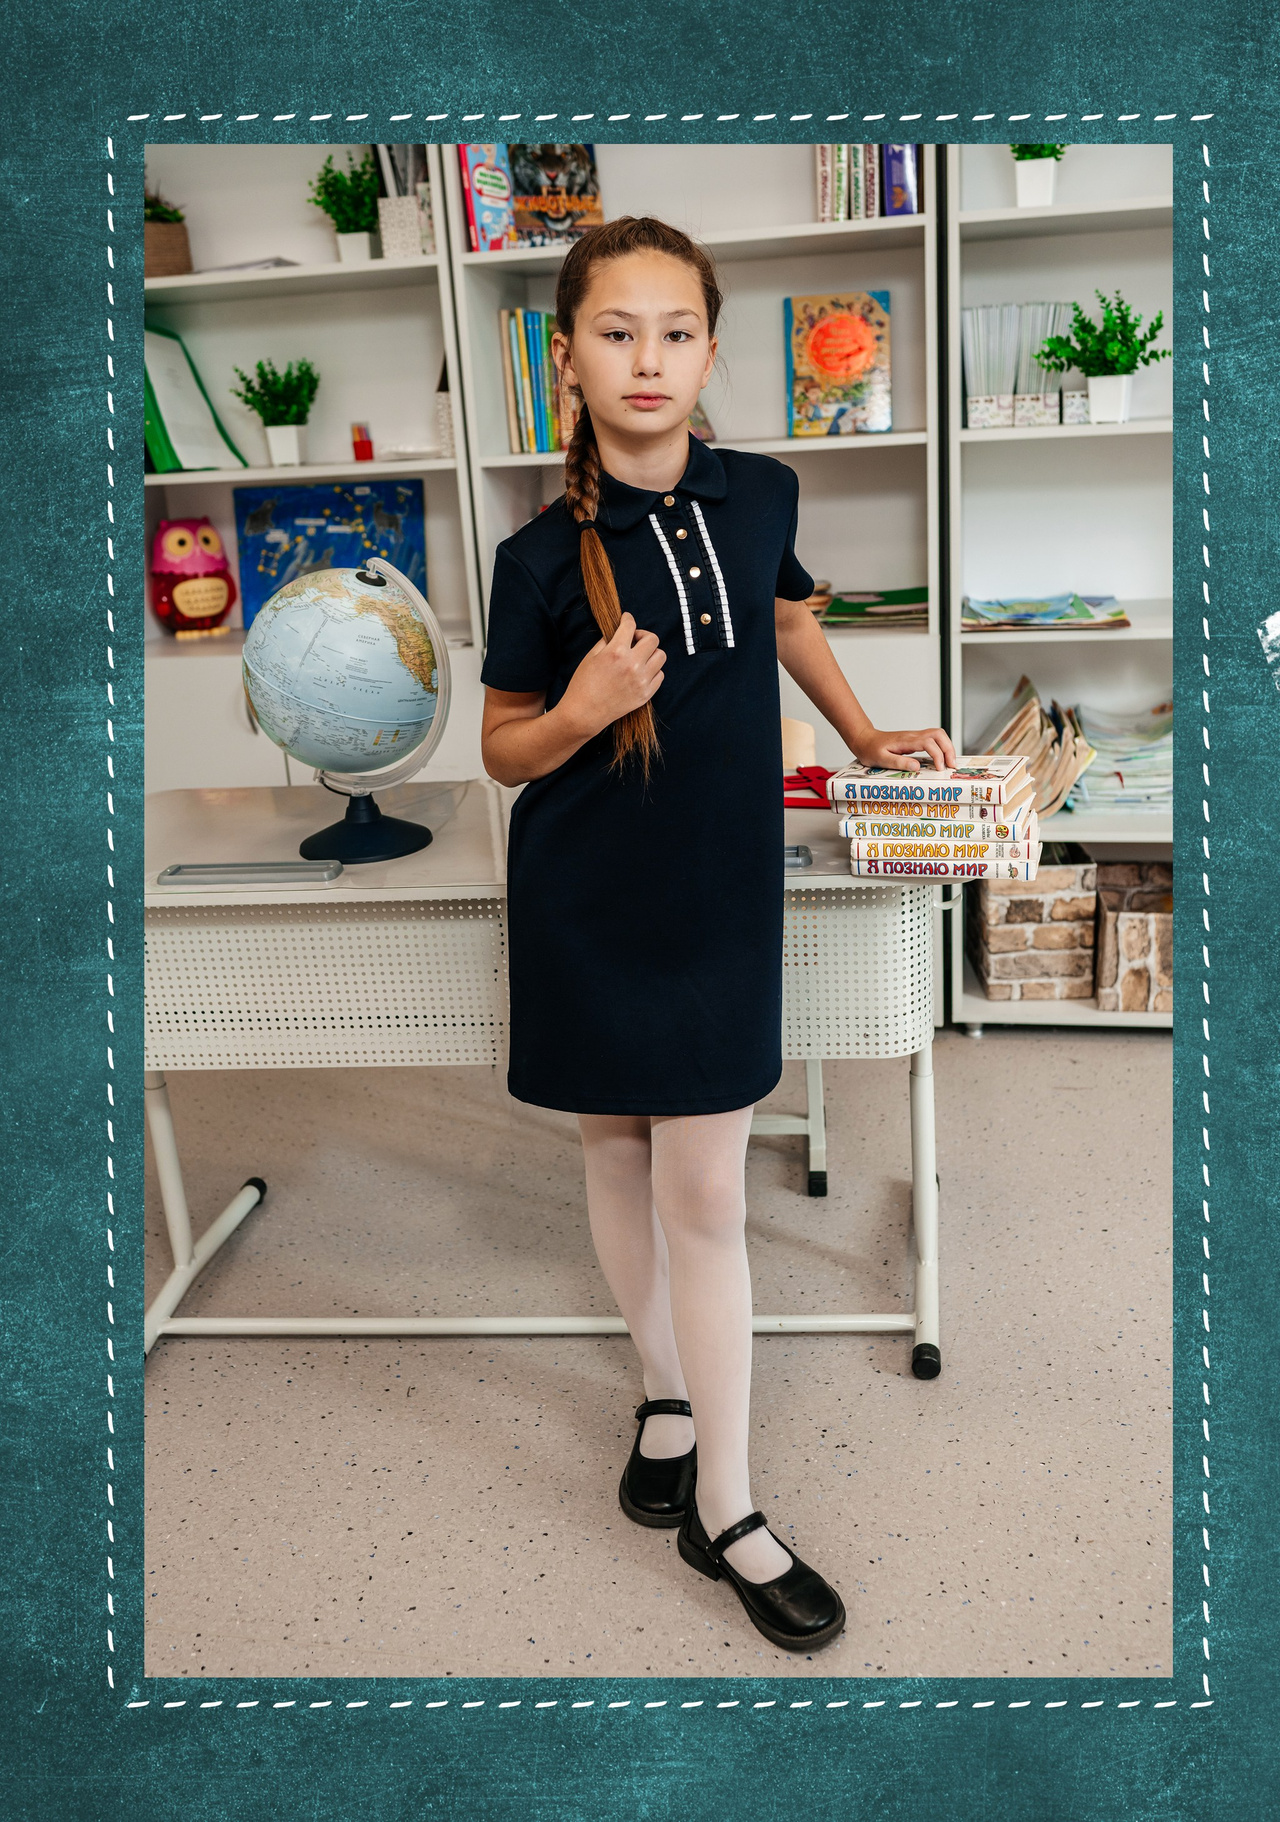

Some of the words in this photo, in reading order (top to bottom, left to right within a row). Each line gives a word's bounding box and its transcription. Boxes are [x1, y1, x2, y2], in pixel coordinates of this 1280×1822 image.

[845, 783, 857, 799] Я
[860, 785, 925, 801] ПОЗНАЮ
[928, 787, 963, 801] МИР
[847, 801, 858, 814] Я
[861, 801, 923, 817] ПОЗНАЮ
[926, 804, 960, 819] МИР
[855, 822, 867, 836] Я
[870, 822, 936, 837] ПОЗНАЮ
[939, 824, 975, 839] МИР
[867, 842, 879, 857] Я
[883, 842, 950, 858] ПОЗНАЮ
[953, 844, 989, 858] МИР
[867, 860, 879, 874] Я
[883, 860, 950, 876] ПОЗНАЮ
[953, 862, 989, 877] МИР
